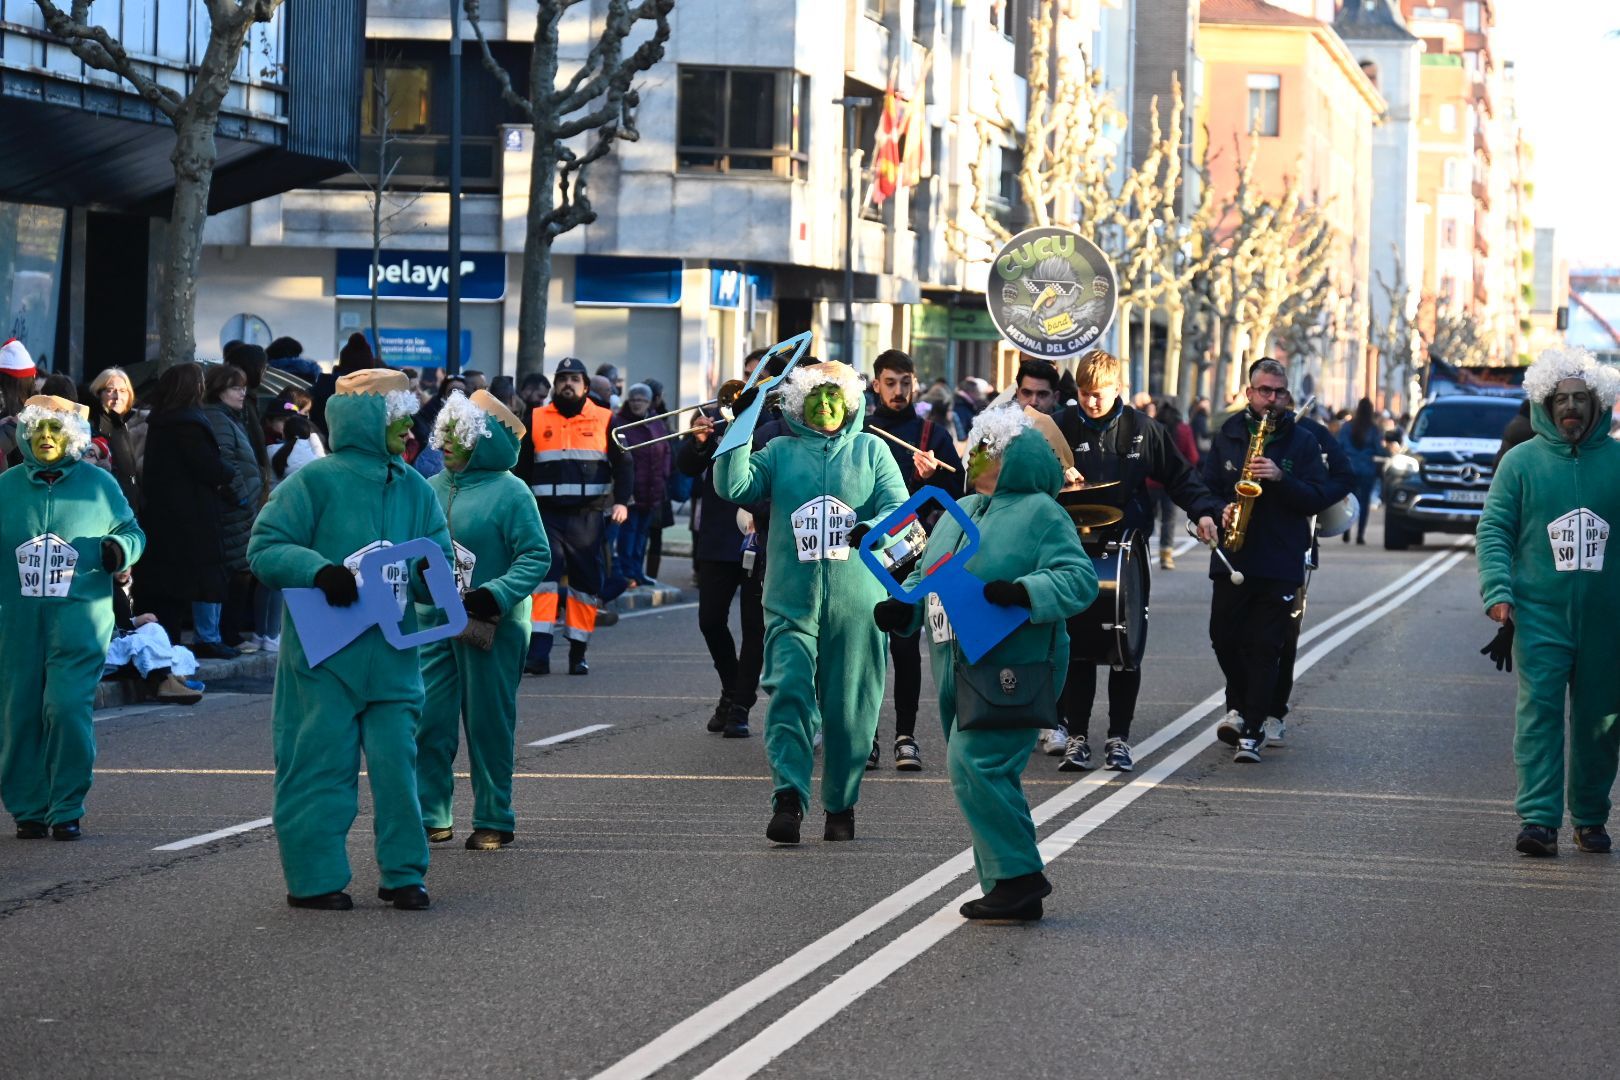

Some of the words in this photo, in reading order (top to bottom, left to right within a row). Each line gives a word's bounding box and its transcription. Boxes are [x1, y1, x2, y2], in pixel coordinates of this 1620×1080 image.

[997, 234, 1075, 281] CUCU
[1047, 317, 1068, 331] band
[1005, 324, 1042, 352] MEDINA
[1046, 343, 1066, 353] DEL
[1067, 325, 1100, 350] CAMPO
[829, 506, 839, 515] AI
[805, 517, 818, 530] TR
[829, 516, 843, 529] OP
[1586, 518, 1595, 527] AI
[801, 535, 818, 552] SO
[828, 531, 843, 547] IF
[1562, 529, 1575, 542] TR
[1585, 528, 1599, 541] OP
[1558, 546, 1574, 562] SO
[1585, 542, 1598, 558] IF
[28, 554, 41, 568] TR
[50, 554, 64, 568] OP
[24, 571, 40, 588] SO
[49, 569, 64, 585] IF
[387, 565, 400, 581] OP
